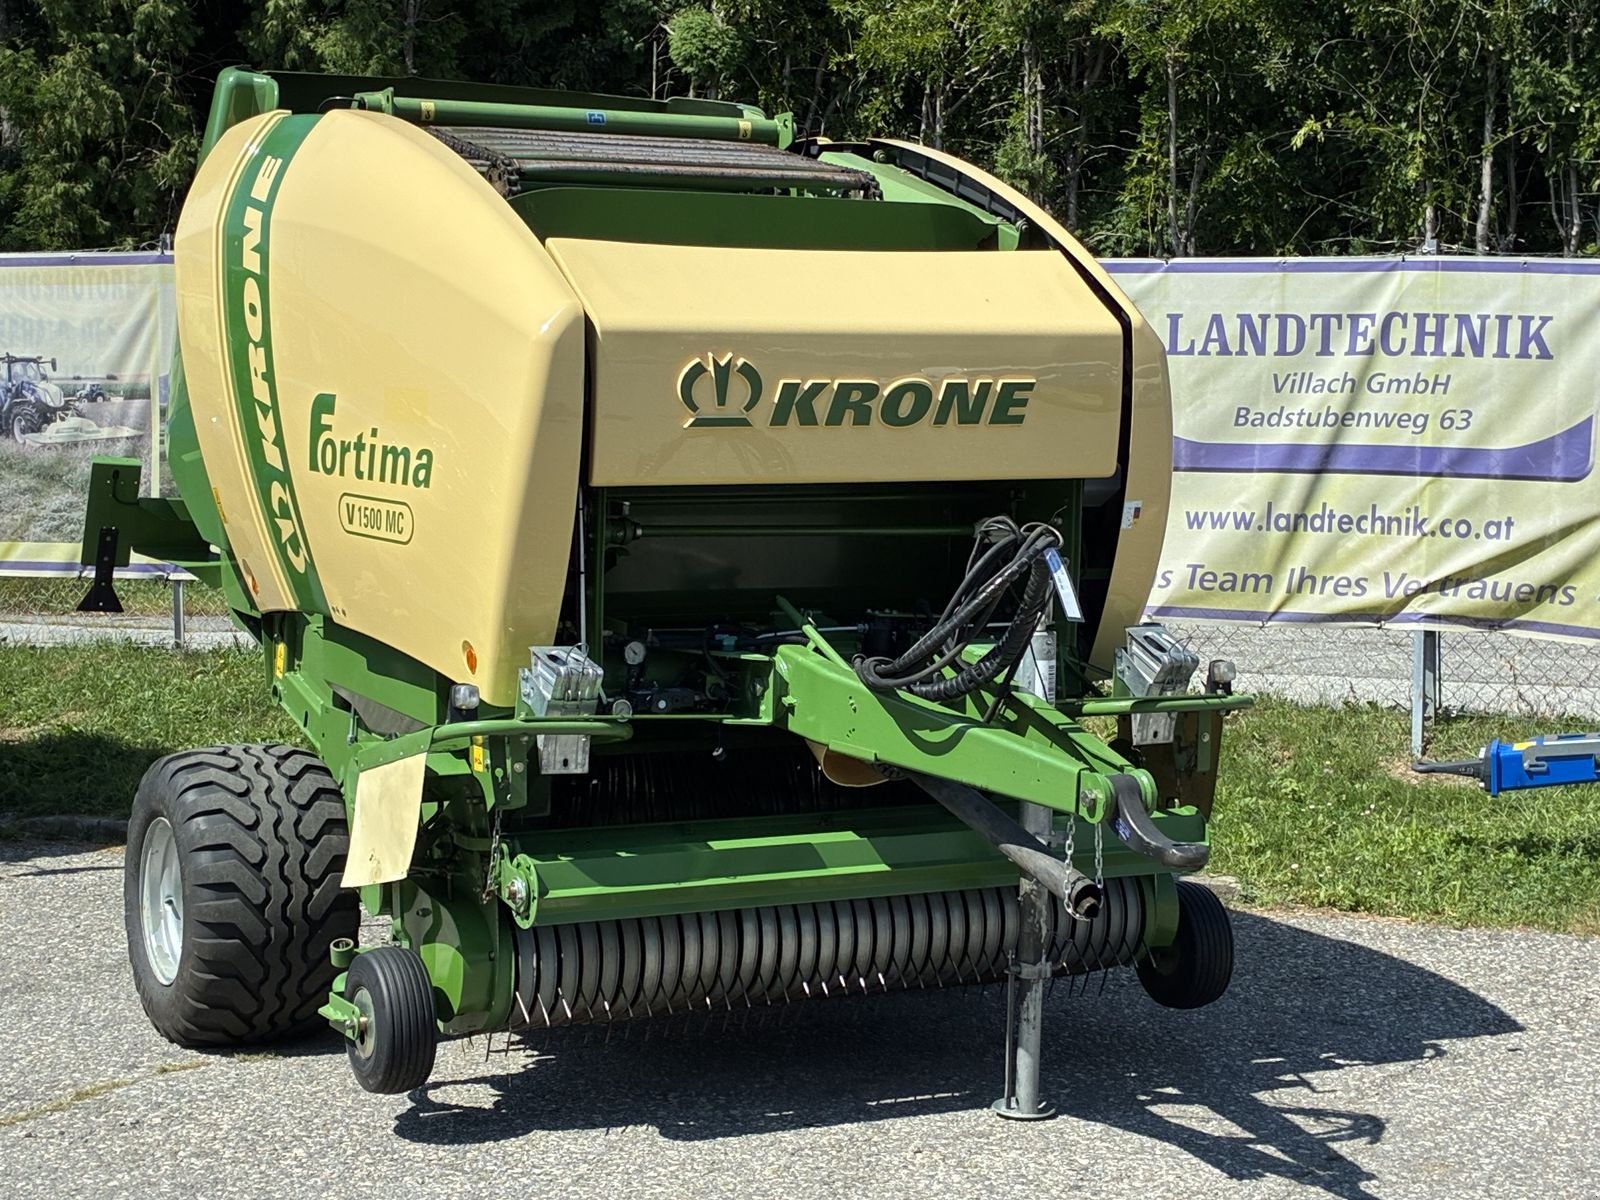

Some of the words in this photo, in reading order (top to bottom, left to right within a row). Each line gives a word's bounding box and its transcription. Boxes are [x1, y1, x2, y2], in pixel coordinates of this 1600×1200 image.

[243, 157, 283, 474] KRONE
[1167, 312, 1553, 360] LANDTECHNIK
[768, 377, 1038, 428] KRONE
[1272, 372, 1357, 395] Villach
[1366, 373, 1452, 396] GmbH
[309, 393, 434, 489] Fortima
[1234, 406, 1429, 434] Badstubenweg
[1439, 408, 1474, 431] 63
[385, 510, 404, 534] MC
[1185, 502, 1515, 541] www.landtechnik.co.at
[1186, 563, 1274, 594] Team
[1285, 566, 1369, 598] Ihres
[1383, 570, 1578, 607] Vertrauens
